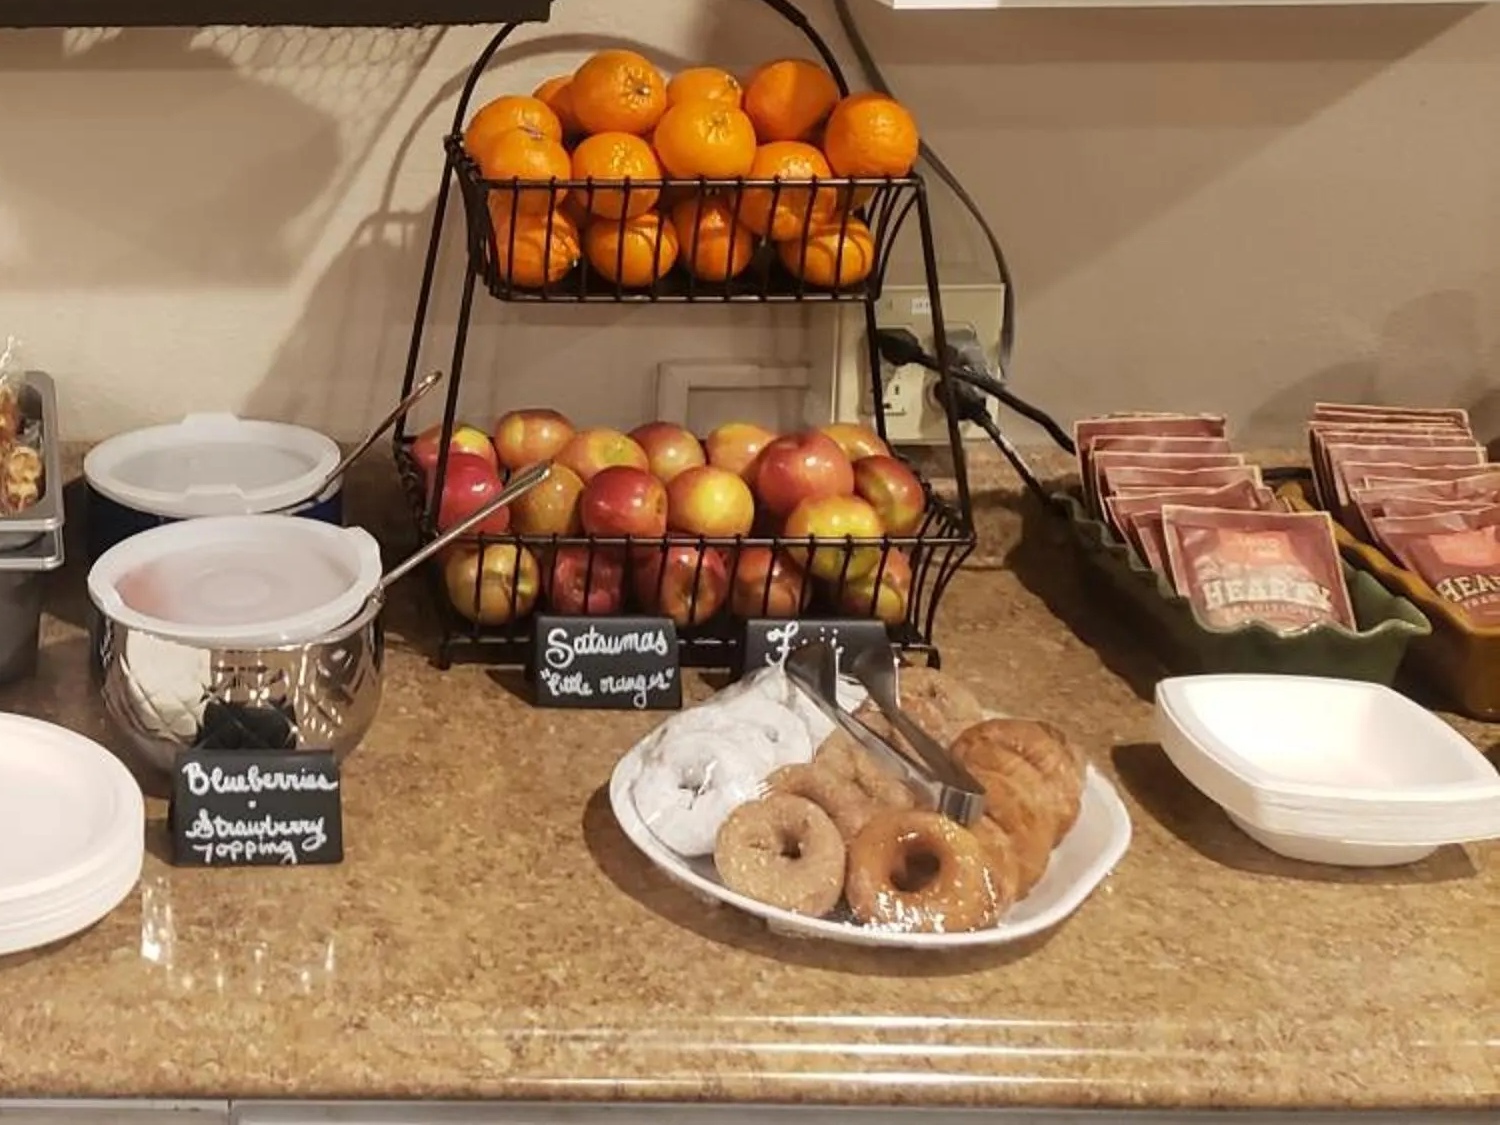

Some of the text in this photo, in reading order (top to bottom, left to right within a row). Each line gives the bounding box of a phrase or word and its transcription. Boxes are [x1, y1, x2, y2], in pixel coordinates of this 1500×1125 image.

[545, 625, 669, 669] Satsumas
[181, 761, 339, 796] Blueberries
[185, 807, 328, 852] Strawberry
